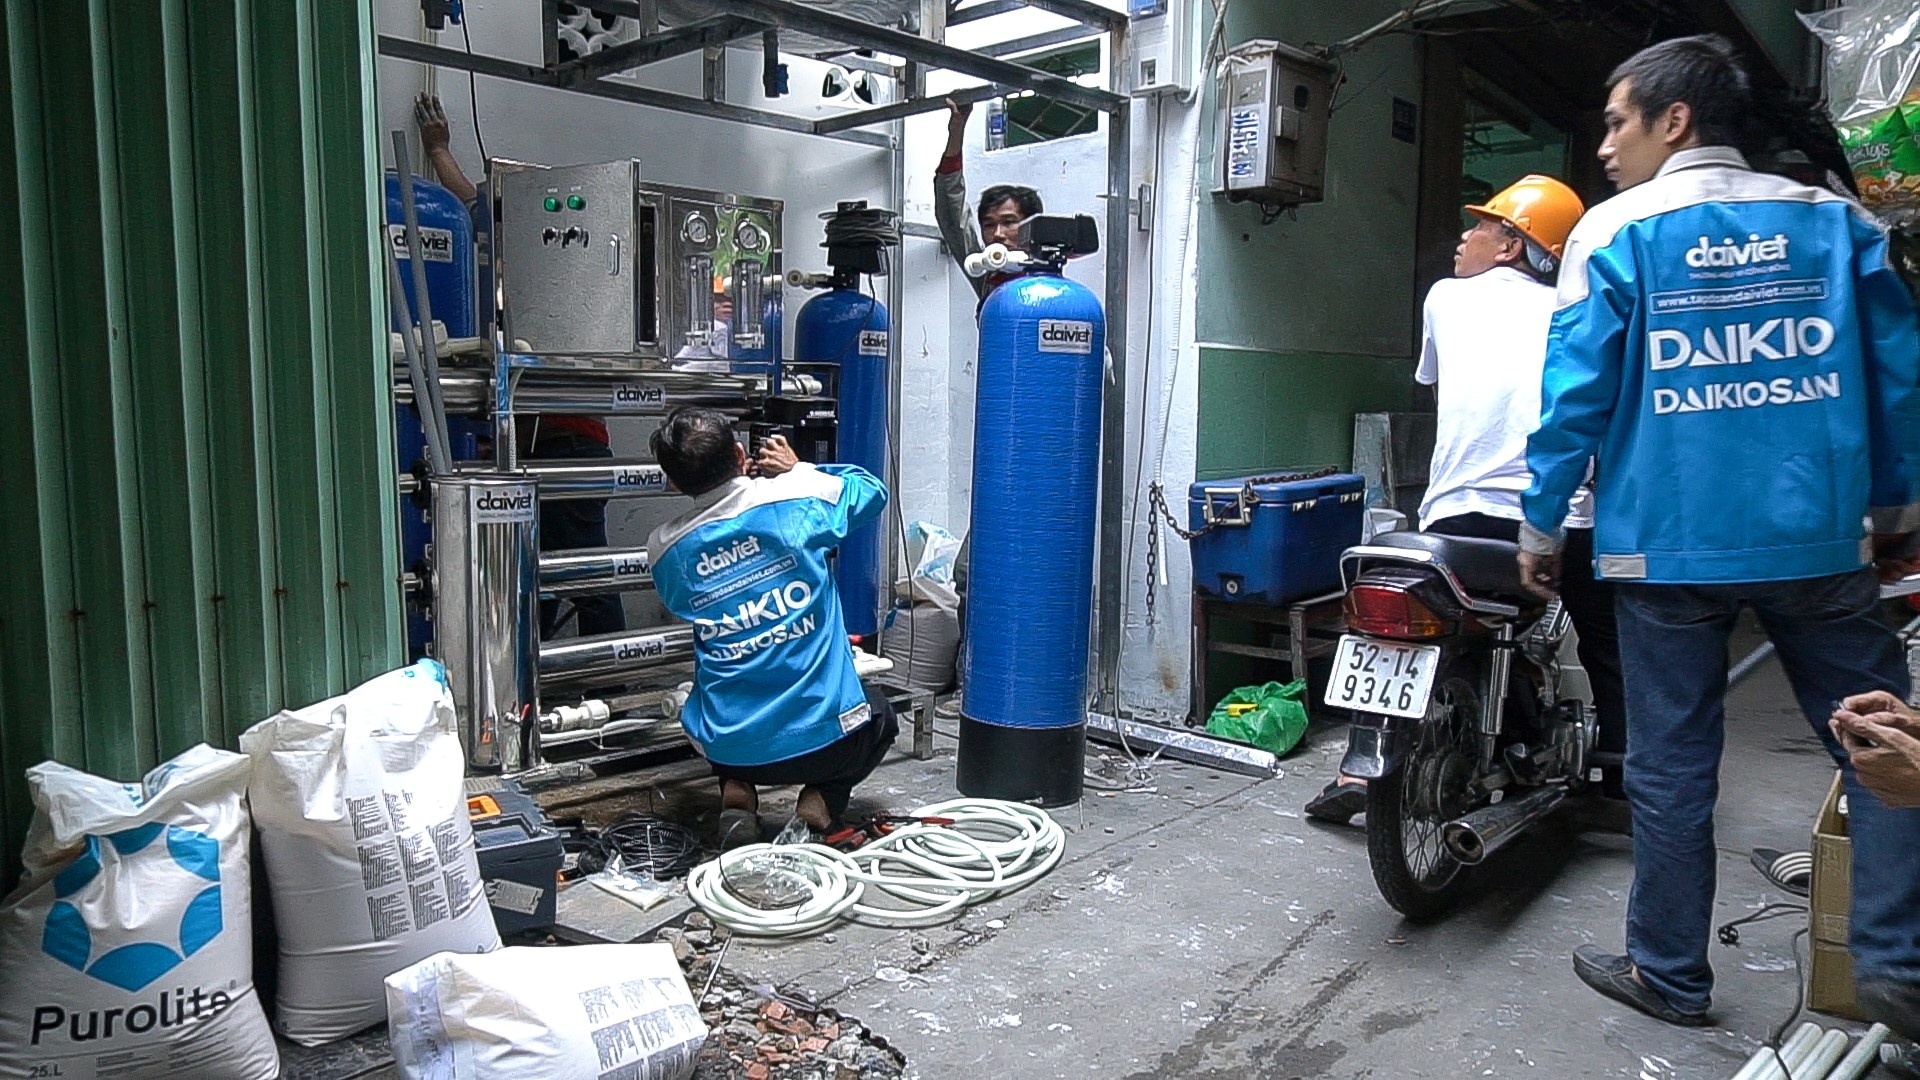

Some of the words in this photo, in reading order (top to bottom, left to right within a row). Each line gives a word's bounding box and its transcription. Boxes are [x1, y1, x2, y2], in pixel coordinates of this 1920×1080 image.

[393, 228, 451, 251] dviet
[1686, 234, 1788, 267] daiviet
[1043, 323, 1090, 342] daiviet
[1648, 317, 1834, 370] DAIKIO
[617, 384, 662, 402] daiviet
[1653, 372, 1840, 414] DAIKIOSAN
[618, 469, 663, 486] daiviet
[477, 490, 532, 510] daiviet
[618, 558, 650, 575] daiv
[696, 535, 760, 576] daiviet
[694, 580, 811, 641] DAIKIO
[618, 641, 662, 660] daiviet
[1341, 675, 1415, 711] 9346
[30, 987, 231, 1046] Purolite
